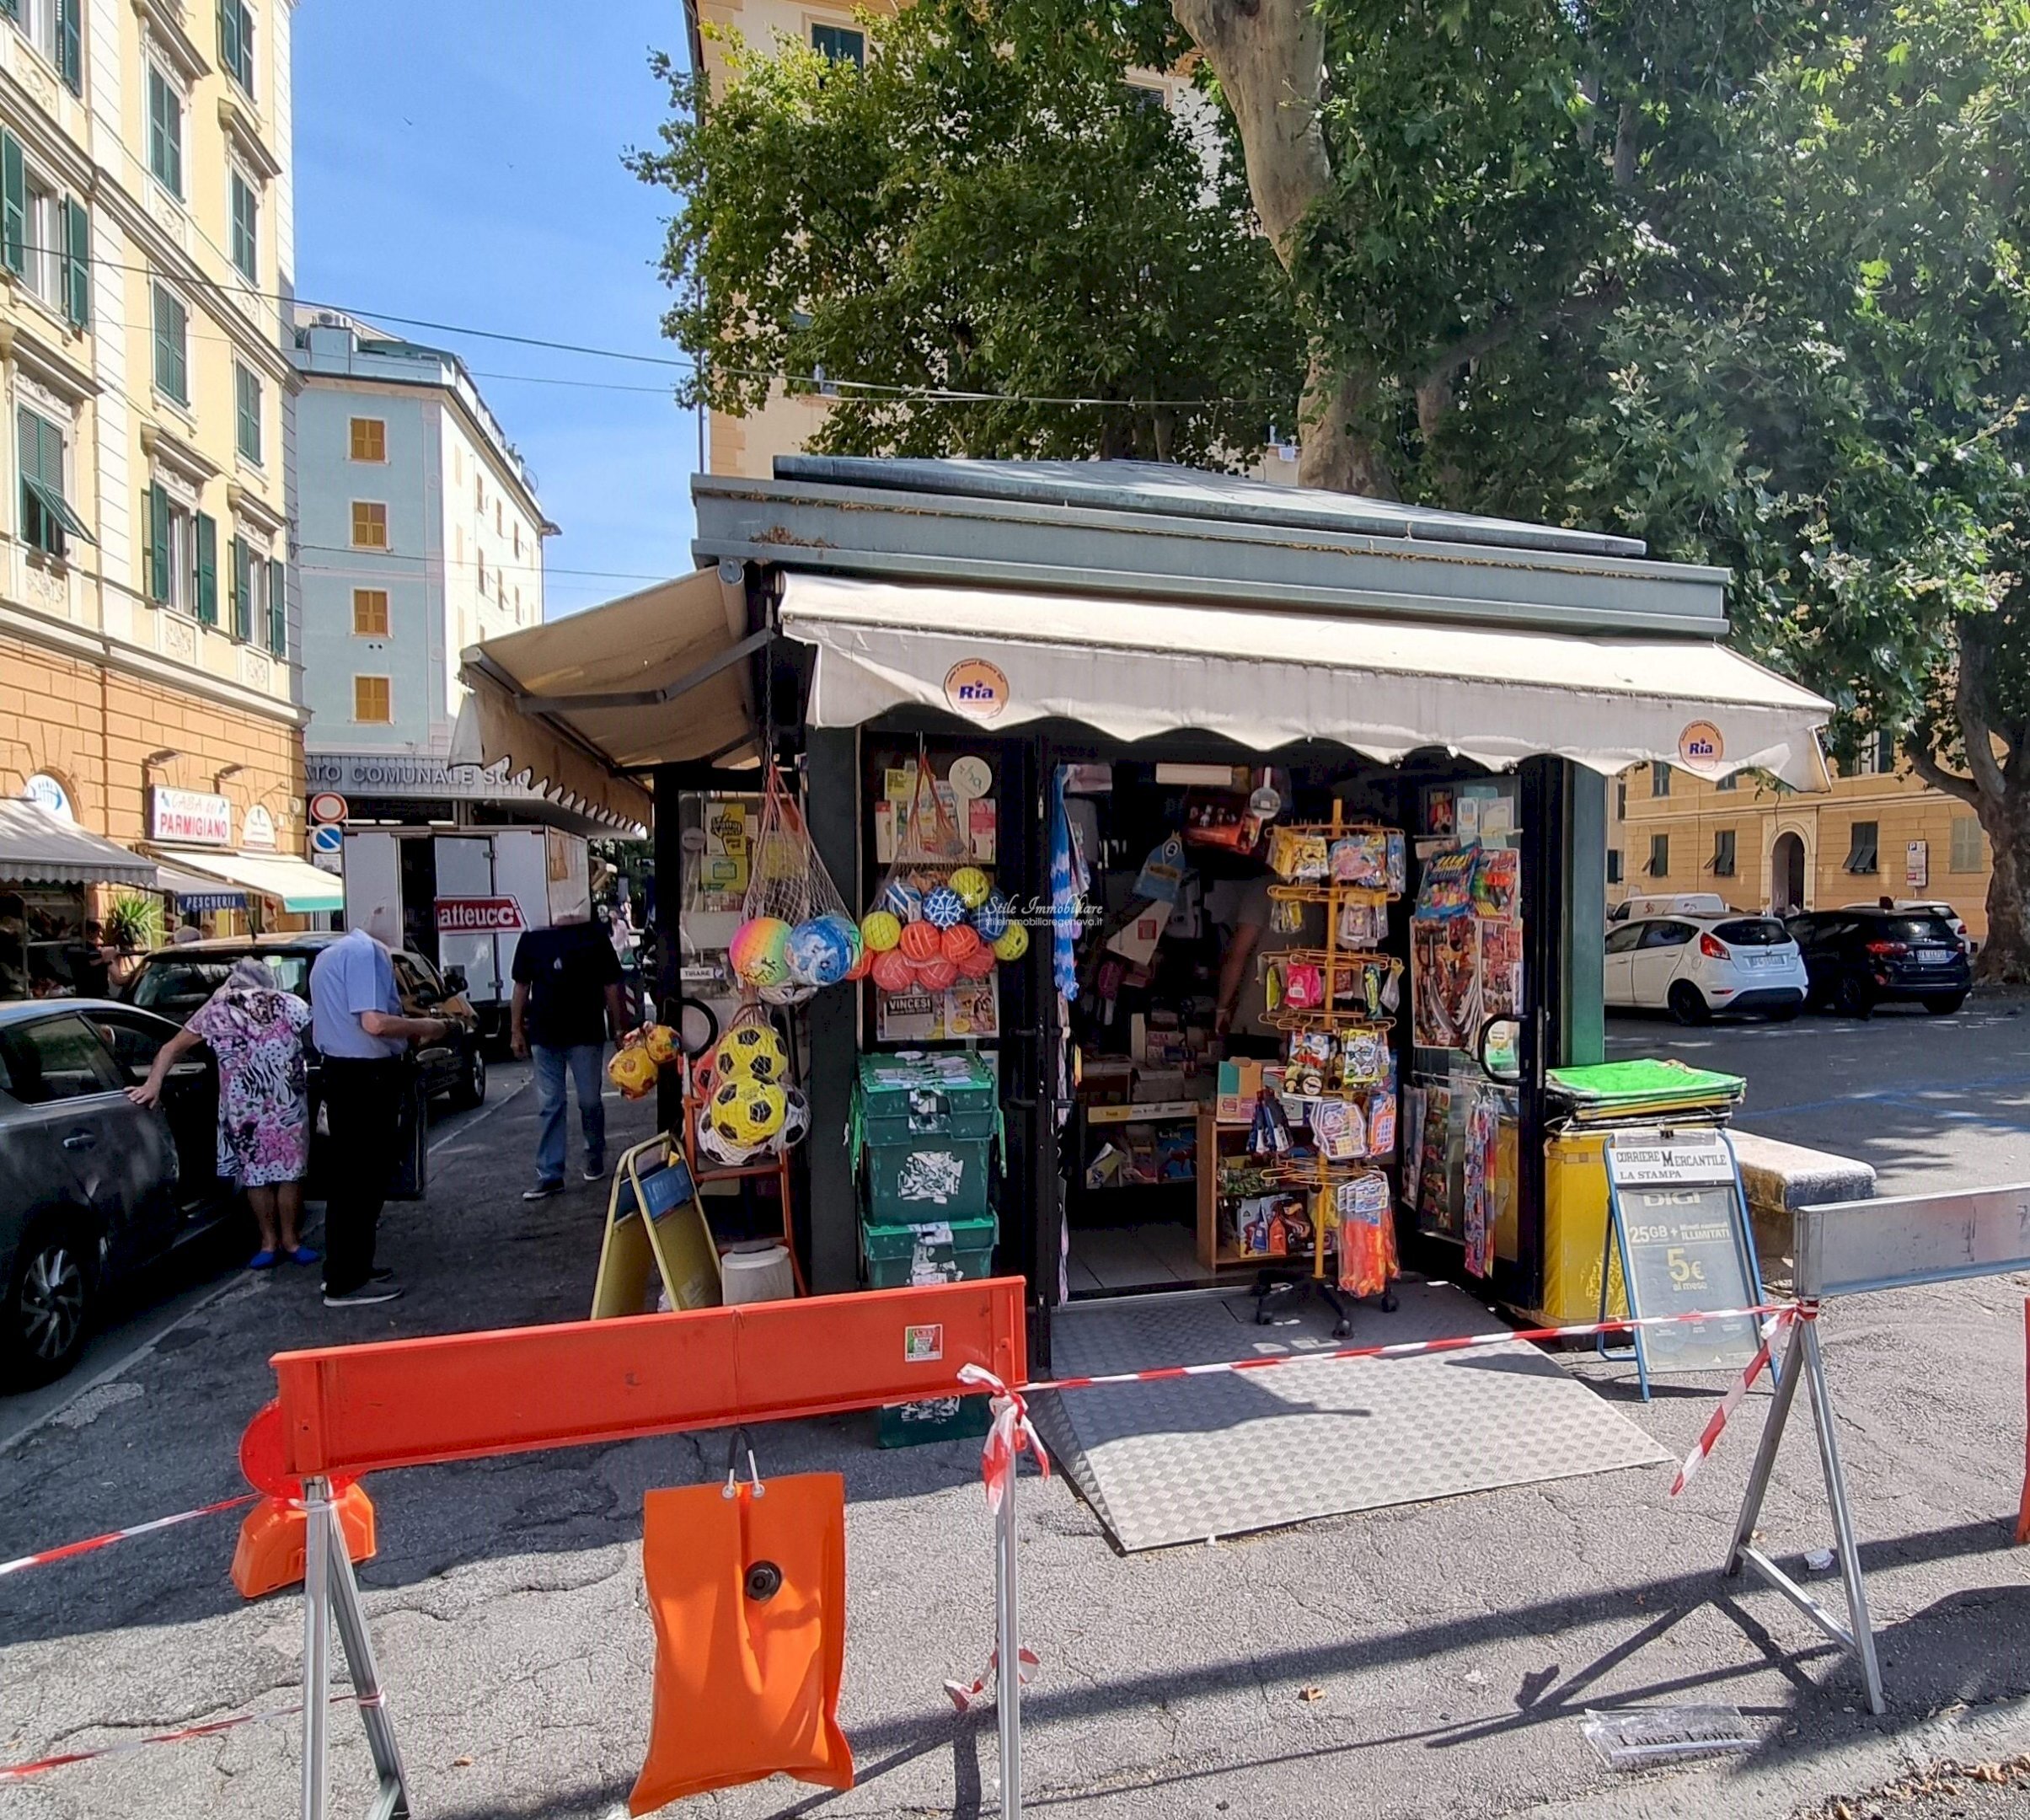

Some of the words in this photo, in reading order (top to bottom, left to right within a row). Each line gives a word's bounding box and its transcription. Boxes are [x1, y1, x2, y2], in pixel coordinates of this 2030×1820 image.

[959, 680, 994, 699] Ria
[1689, 737, 1713, 754] Ria
[352, 766, 474, 784] COMUNALE
[160, 812, 228, 838] PARMIGIANO
[186, 895, 236, 909] PESCHERIA
[1616, 1151, 1660, 1163] CORRIERE
[1661, 1150, 1727, 1167] MERCANTILE
[1620, 1171, 1635, 1180] LA
[1637, 1170, 1682, 1180] STAMPA
